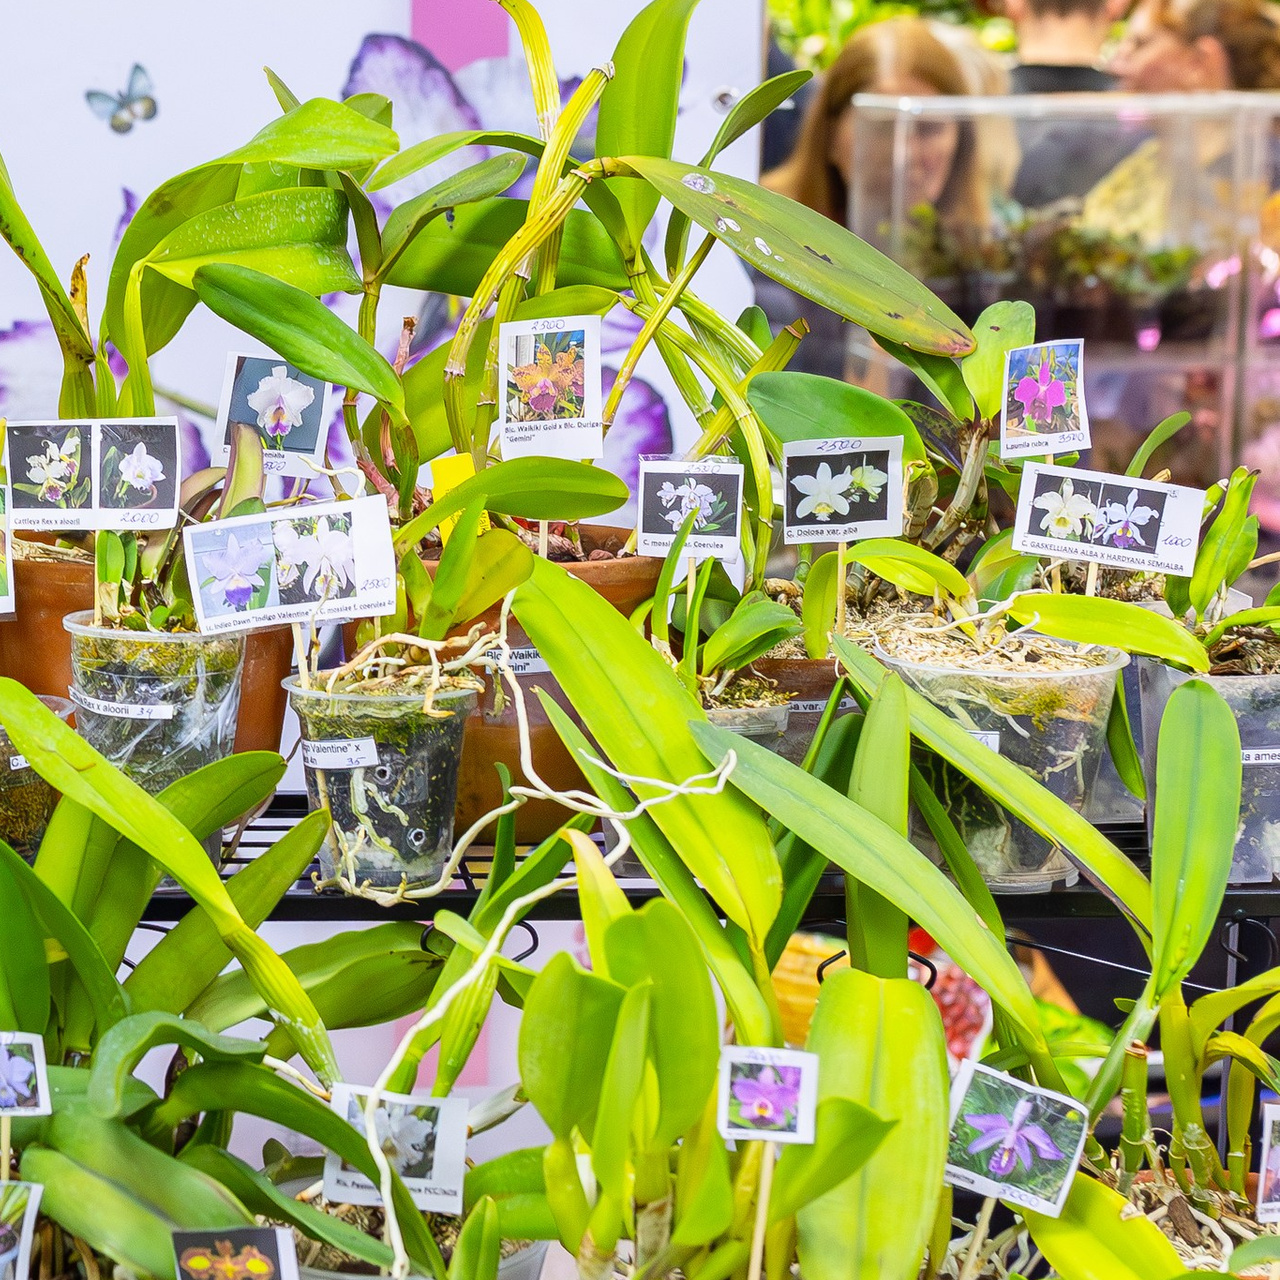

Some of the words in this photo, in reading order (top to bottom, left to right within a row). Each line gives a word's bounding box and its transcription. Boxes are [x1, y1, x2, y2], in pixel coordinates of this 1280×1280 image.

[531, 319, 565, 330] 2500
[518, 424, 541, 433] Waikiki
[543, 423, 557, 431] Gold
[816, 439, 862, 452] 2500
[263, 452, 285, 460] emialba
[120, 512, 160, 524] 2000
[797, 528, 825, 537] Dolosa
[651, 539, 674, 547] mossi
[1030, 540, 1079, 554] GASKELLIANA
[1081, 549, 1098, 558] ALBA
[1106, 553, 1146, 566] HARDYANA
[1147, 559, 1184, 572] SEMIALBA
[233, 618, 250, 627] Dawn
[277, 609, 313, 621] Valentine"
[509, 650, 542, 660] Waikik
[310, 743, 351, 754] Valentine"
